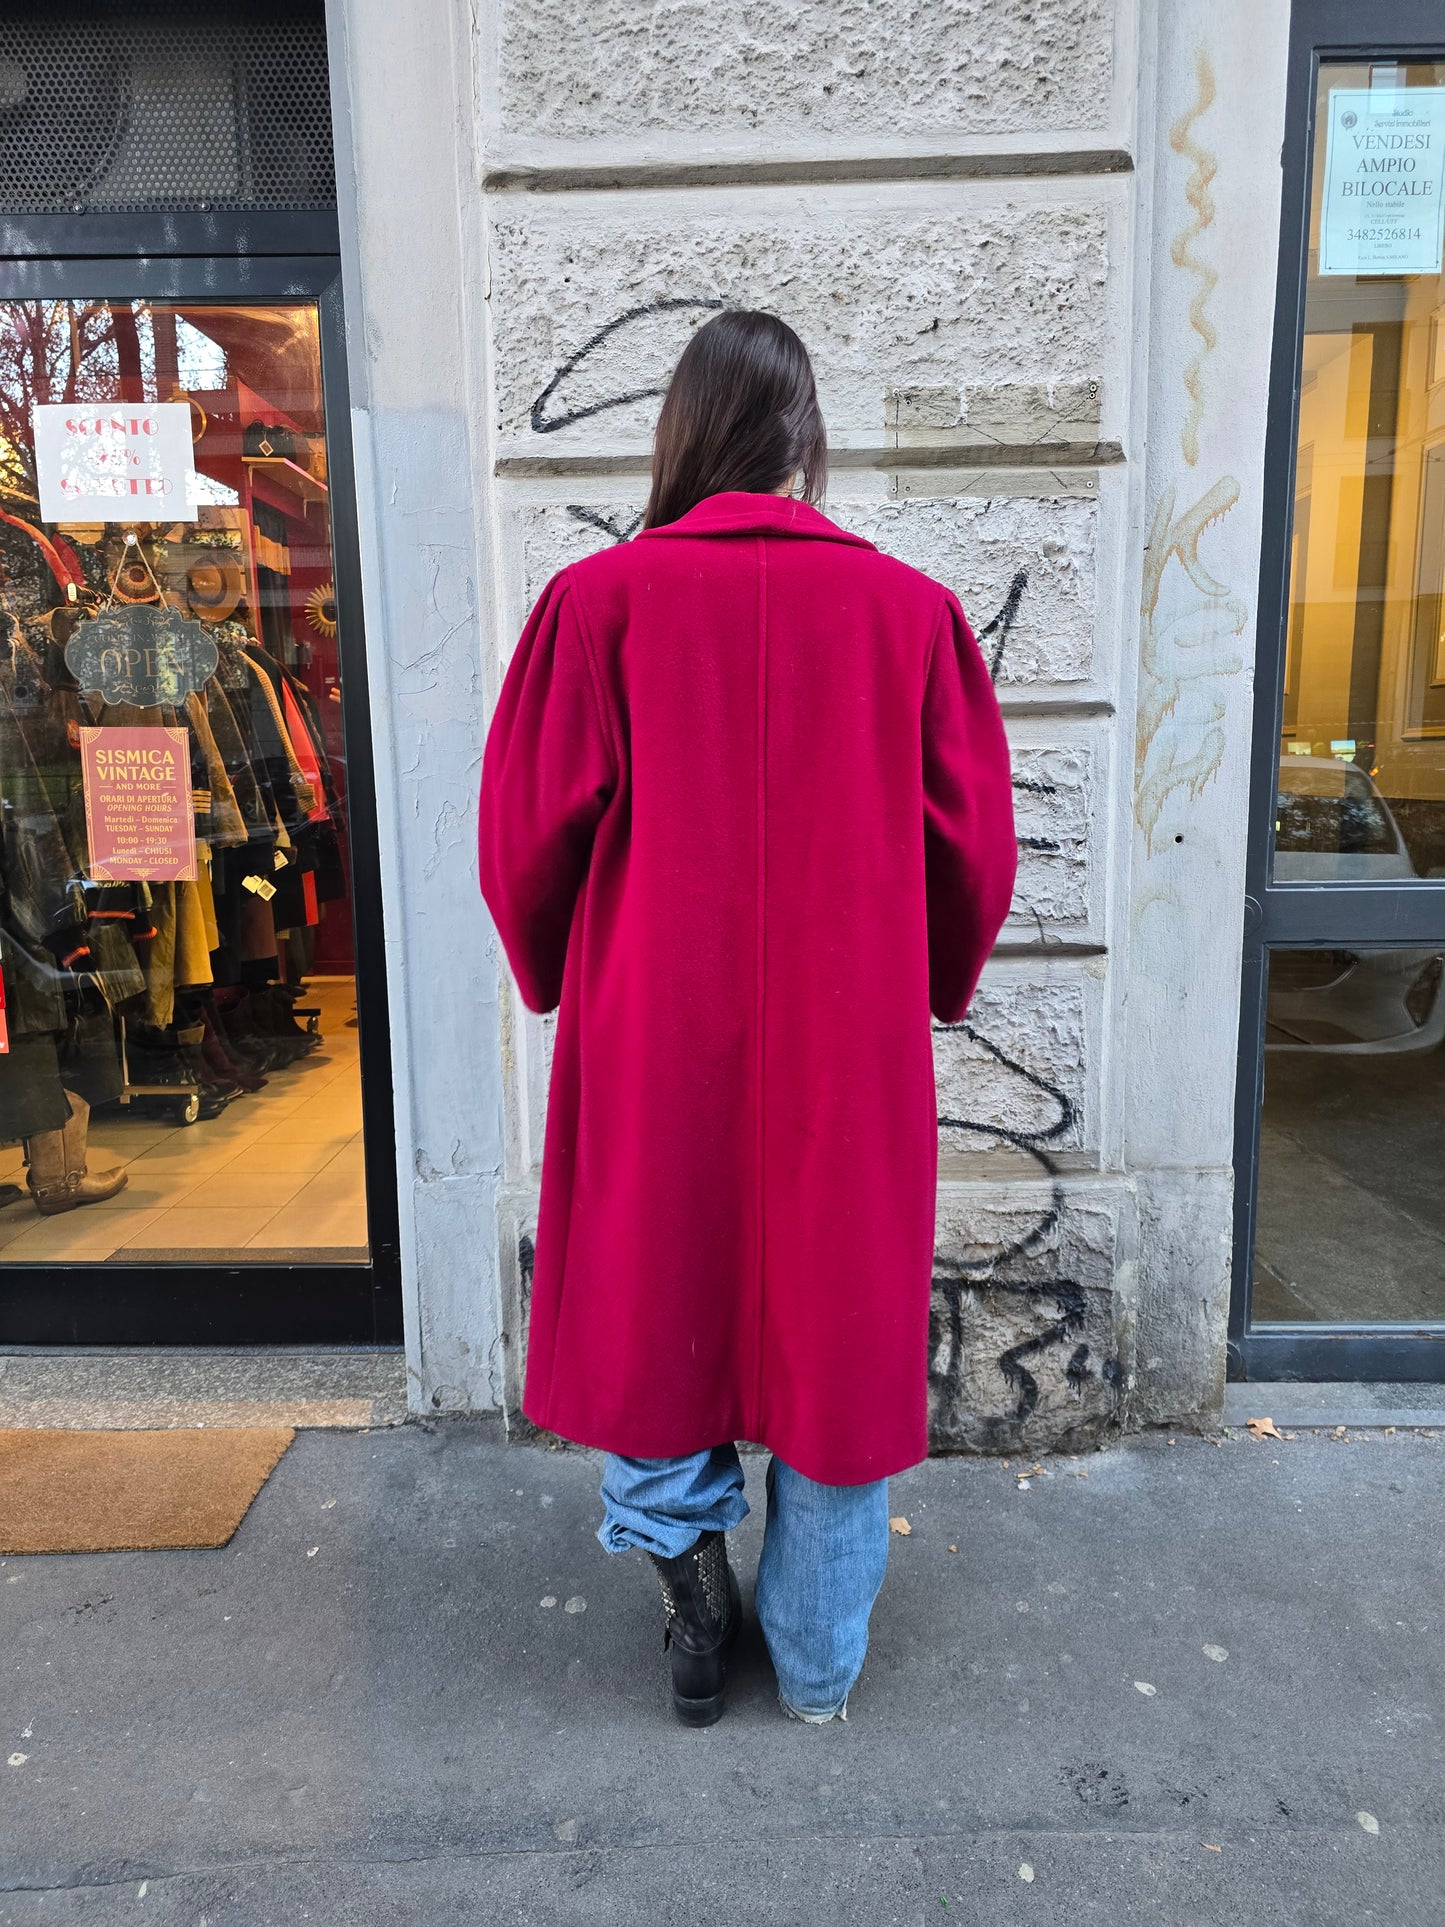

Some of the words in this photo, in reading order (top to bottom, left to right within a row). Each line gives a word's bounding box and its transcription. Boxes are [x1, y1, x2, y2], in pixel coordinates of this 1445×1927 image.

[1352, 134, 1431, 150] VENDESI
[1356, 157, 1416, 173] AMPIO
[1341, 180, 1433, 197] BILOCALE
[1347, 228, 1421, 241] 3482526814
[65, 418, 159, 436] SCONTO
[100, 648, 185, 678] OPEN
[95, 749, 175, 765] SISMICA
[96, 766, 177, 781] VINTAGE
[115, 783, 134, 791] AND
[136, 783, 161, 791] MORE
[99, 795, 125, 804] ORARI
[126, 795, 135, 804] DI
[137, 795, 178, 804] APERTURA
[107, 804, 143, 812] OPENING
[144, 804, 172, 812] HOURS
[141, 815, 178, 824] Domenica
[117, 836, 139, 844] 10:00
[146, 836, 167, 845] 19:30
[144, 847, 172, 855] CHIUSI
[109, 857, 142, 865] MONDAY
[149, 857, 179, 865] CLOSED
